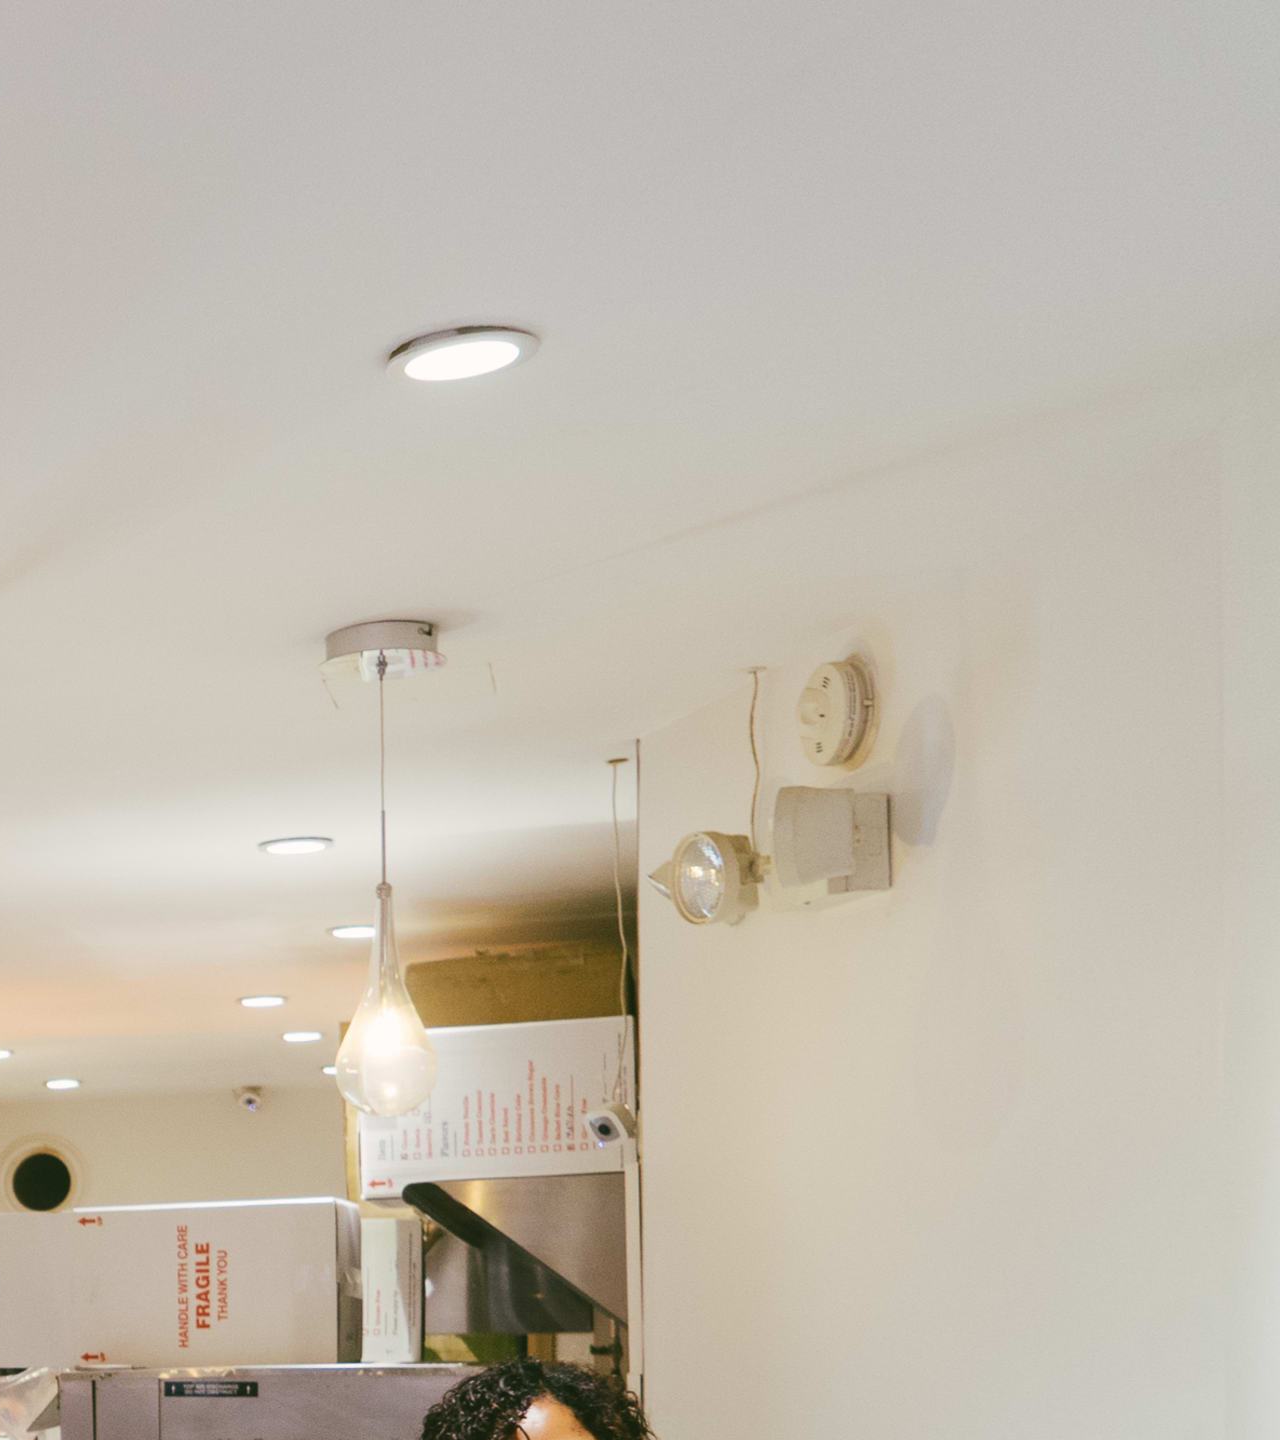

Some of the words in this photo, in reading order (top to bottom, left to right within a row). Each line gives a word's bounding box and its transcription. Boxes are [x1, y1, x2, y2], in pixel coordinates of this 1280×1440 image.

[177, 1224, 188, 1260] CARE
[177, 1262, 188, 1295] WITH
[216, 1249, 228, 1276] YOU
[195, 1242, 210, 1329] FRAGILE
[217, 1278, 228, 1321] THANK
[178, 1296, 189, 1348] HANDLE
